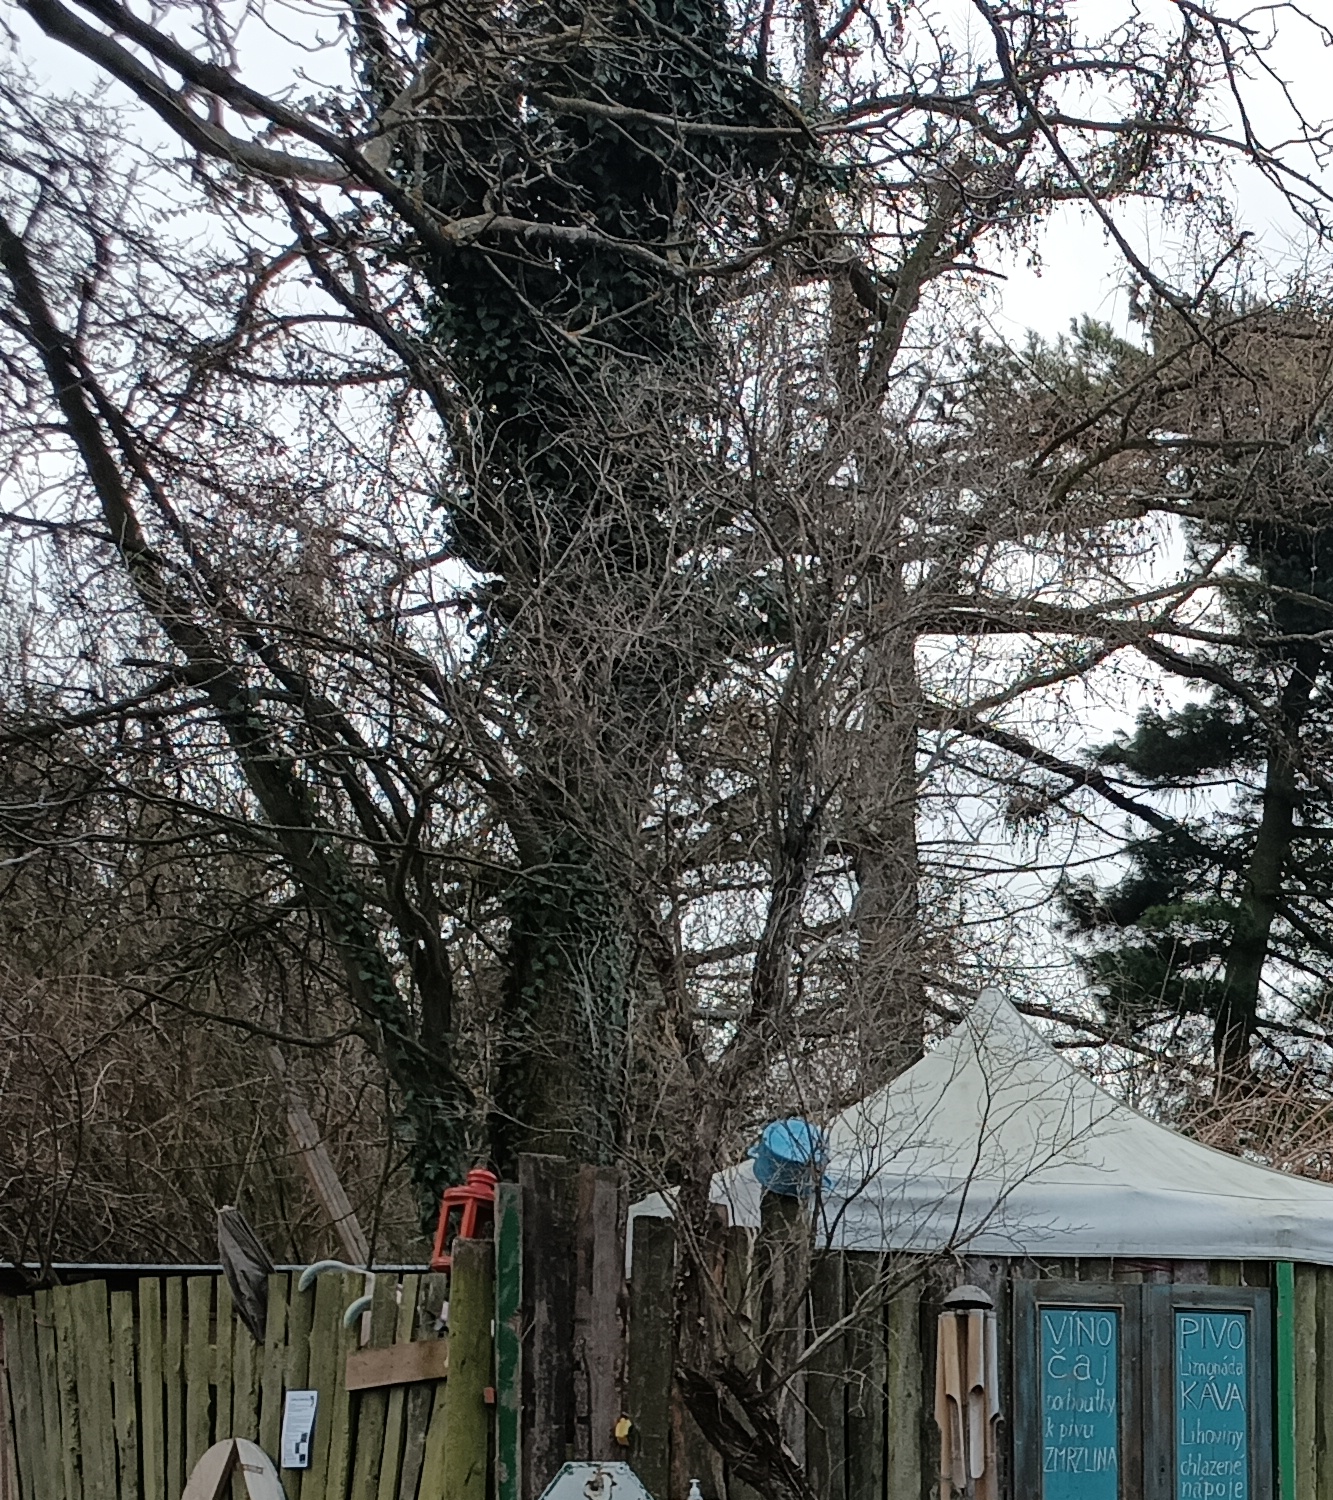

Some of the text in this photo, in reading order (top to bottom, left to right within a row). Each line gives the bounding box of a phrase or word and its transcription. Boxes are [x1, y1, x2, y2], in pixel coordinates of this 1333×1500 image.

[1044, 1310, 1112, 1347] VÍNO
[1180, 1317, 1244, 1350] PIVO
[1180, 1350, 1243, 1376] Limonáda
[1180, 1376, 1245, 1411] KÁVA
[1045, 1416, 1094, 1445] k pivu
[1181, 1418, 1243, 1451] Lihoviny
[1043, 1446, 1118, 1474] ZMRZLINA
[1180, 1453, 1245, 1476] chlazené
